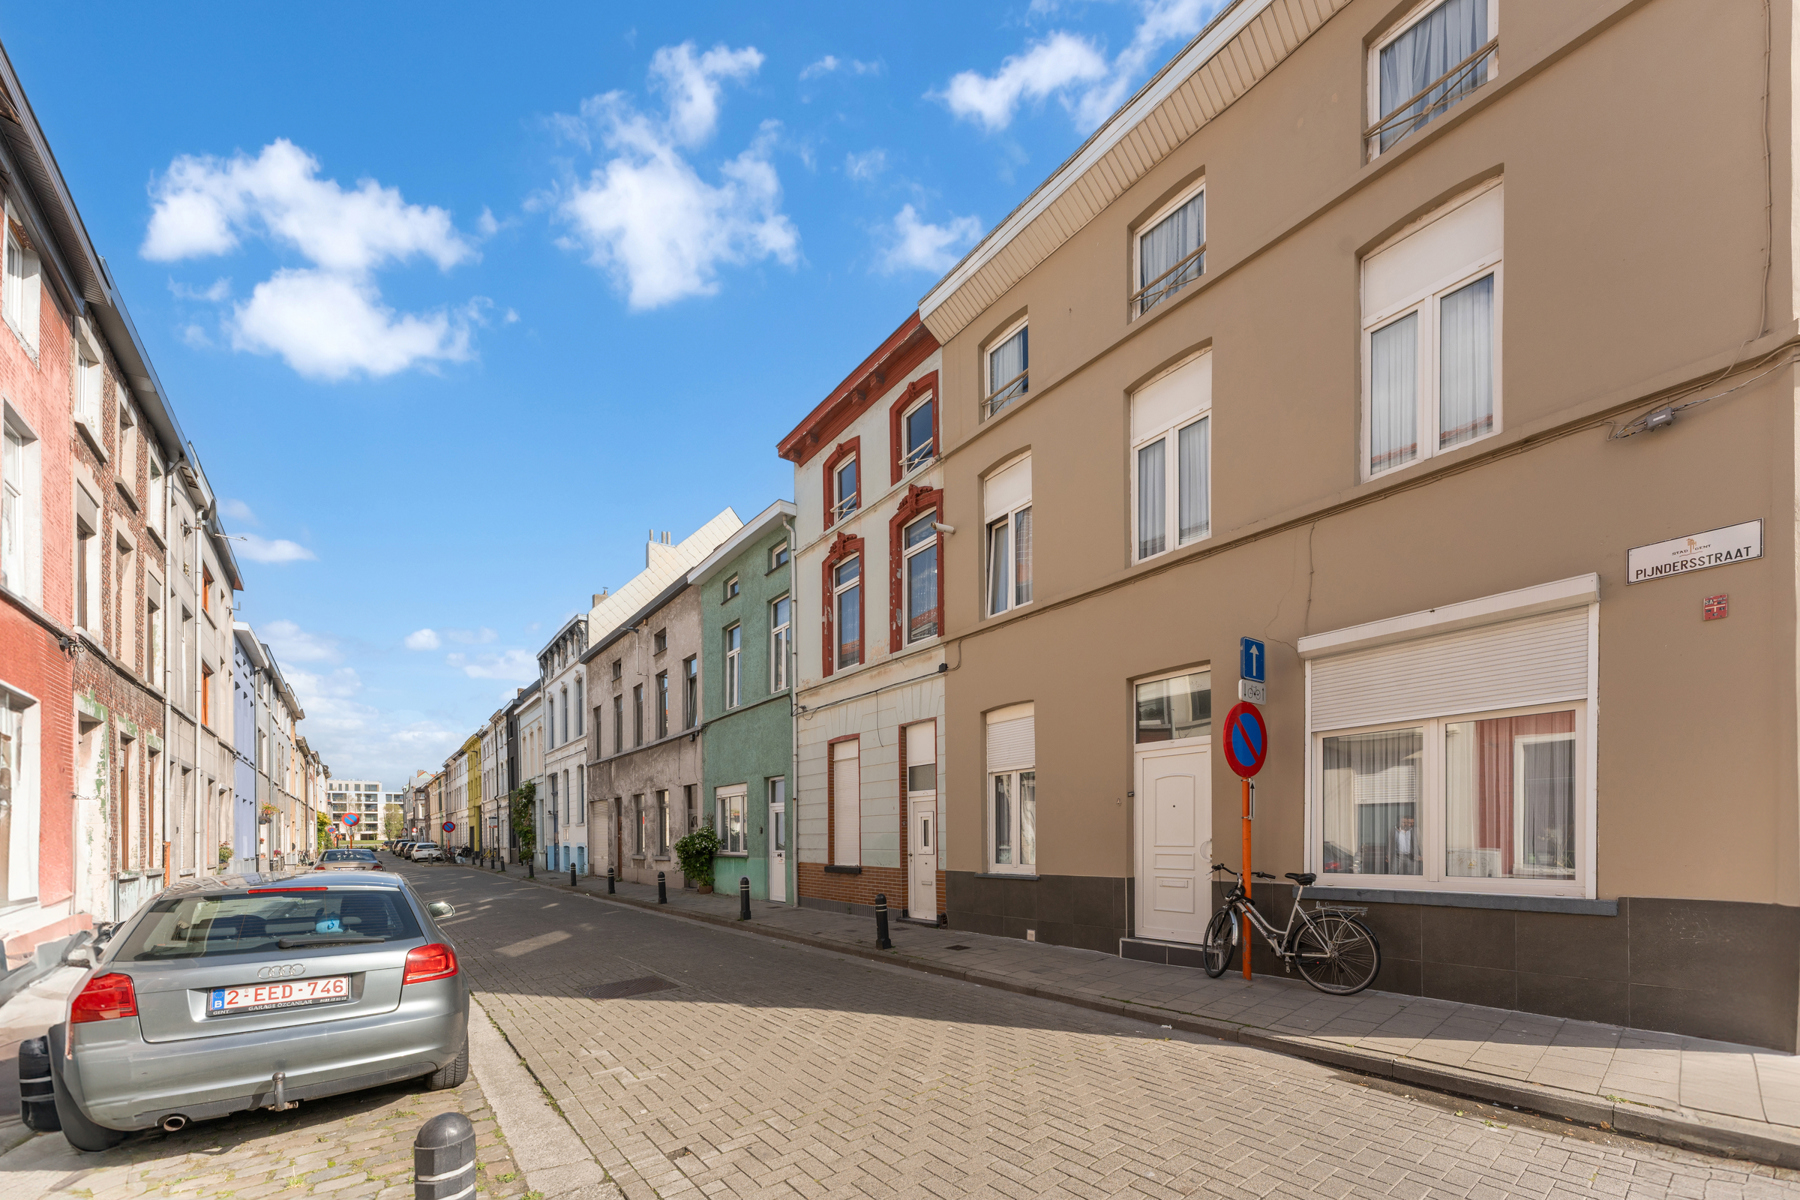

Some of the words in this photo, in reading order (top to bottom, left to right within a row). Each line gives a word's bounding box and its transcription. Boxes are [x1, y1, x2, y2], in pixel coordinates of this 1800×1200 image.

[1635, 546, 1752, 580] PIJNDERSSTRAAT
[214, 1000, 223, 1008] B
[248, 1003, 276, 1012] GARAGE
